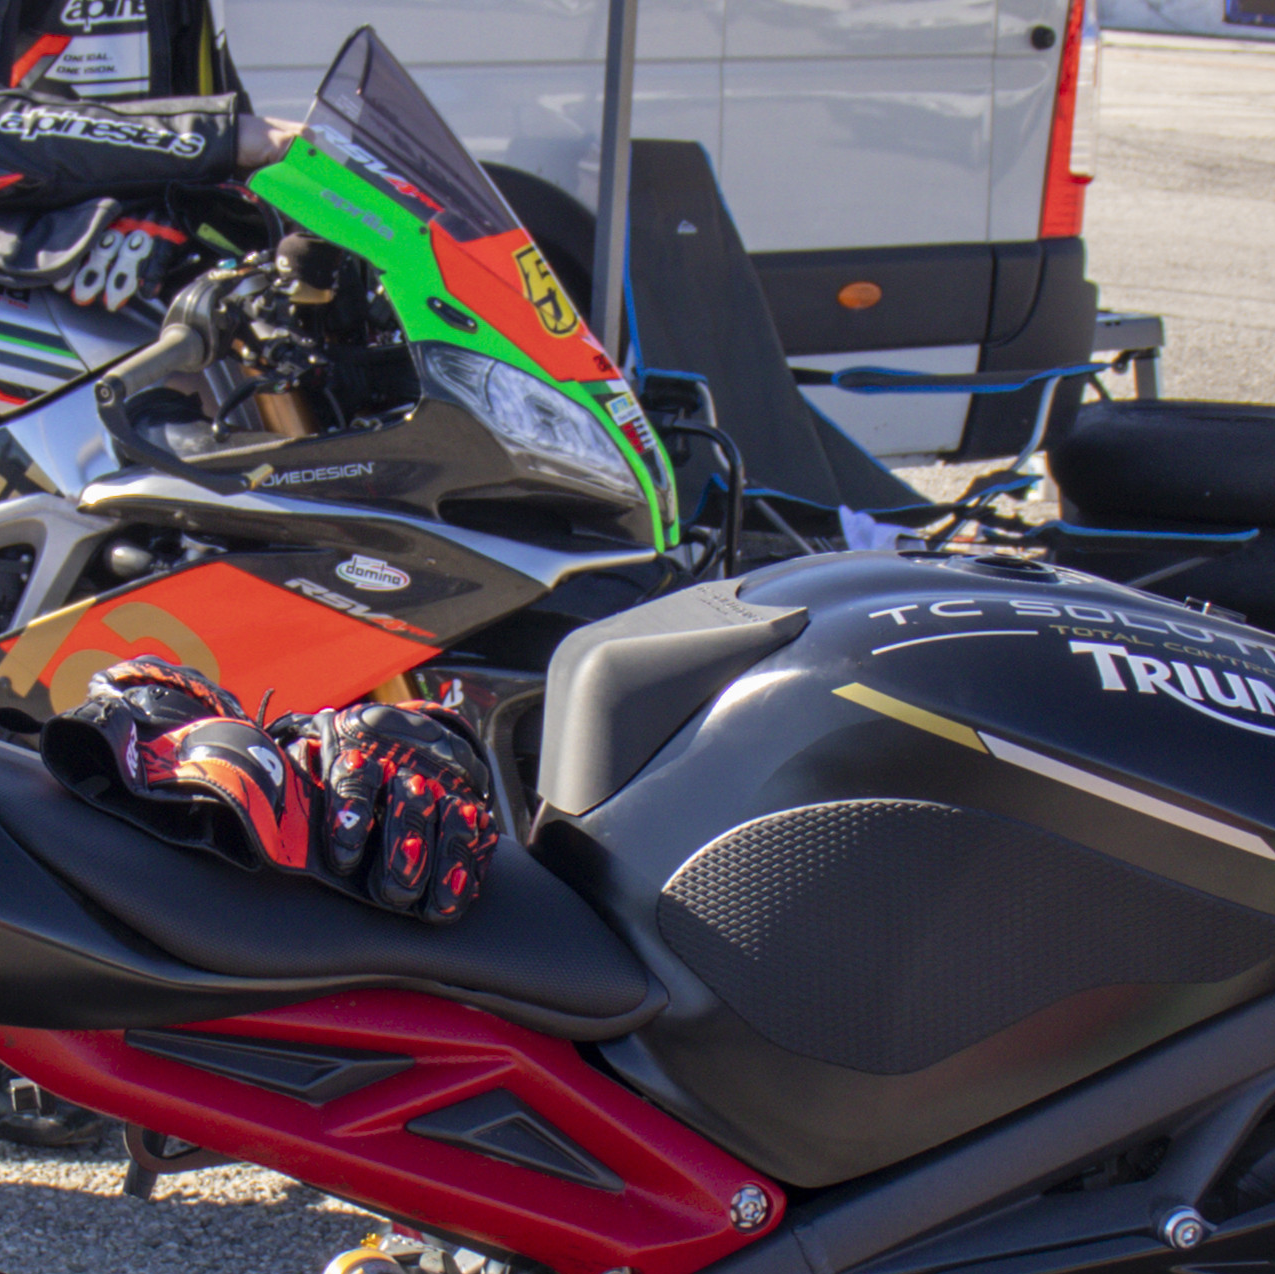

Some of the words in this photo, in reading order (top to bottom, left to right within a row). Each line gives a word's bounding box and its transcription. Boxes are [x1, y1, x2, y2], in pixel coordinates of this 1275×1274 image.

[320, 188, 395, 241] aprilia
[260, 461, 374, 487] ONEDESIGN
[868, 599, 984, 626] TC
[1048, 623, 1155, 647] TOTAL
